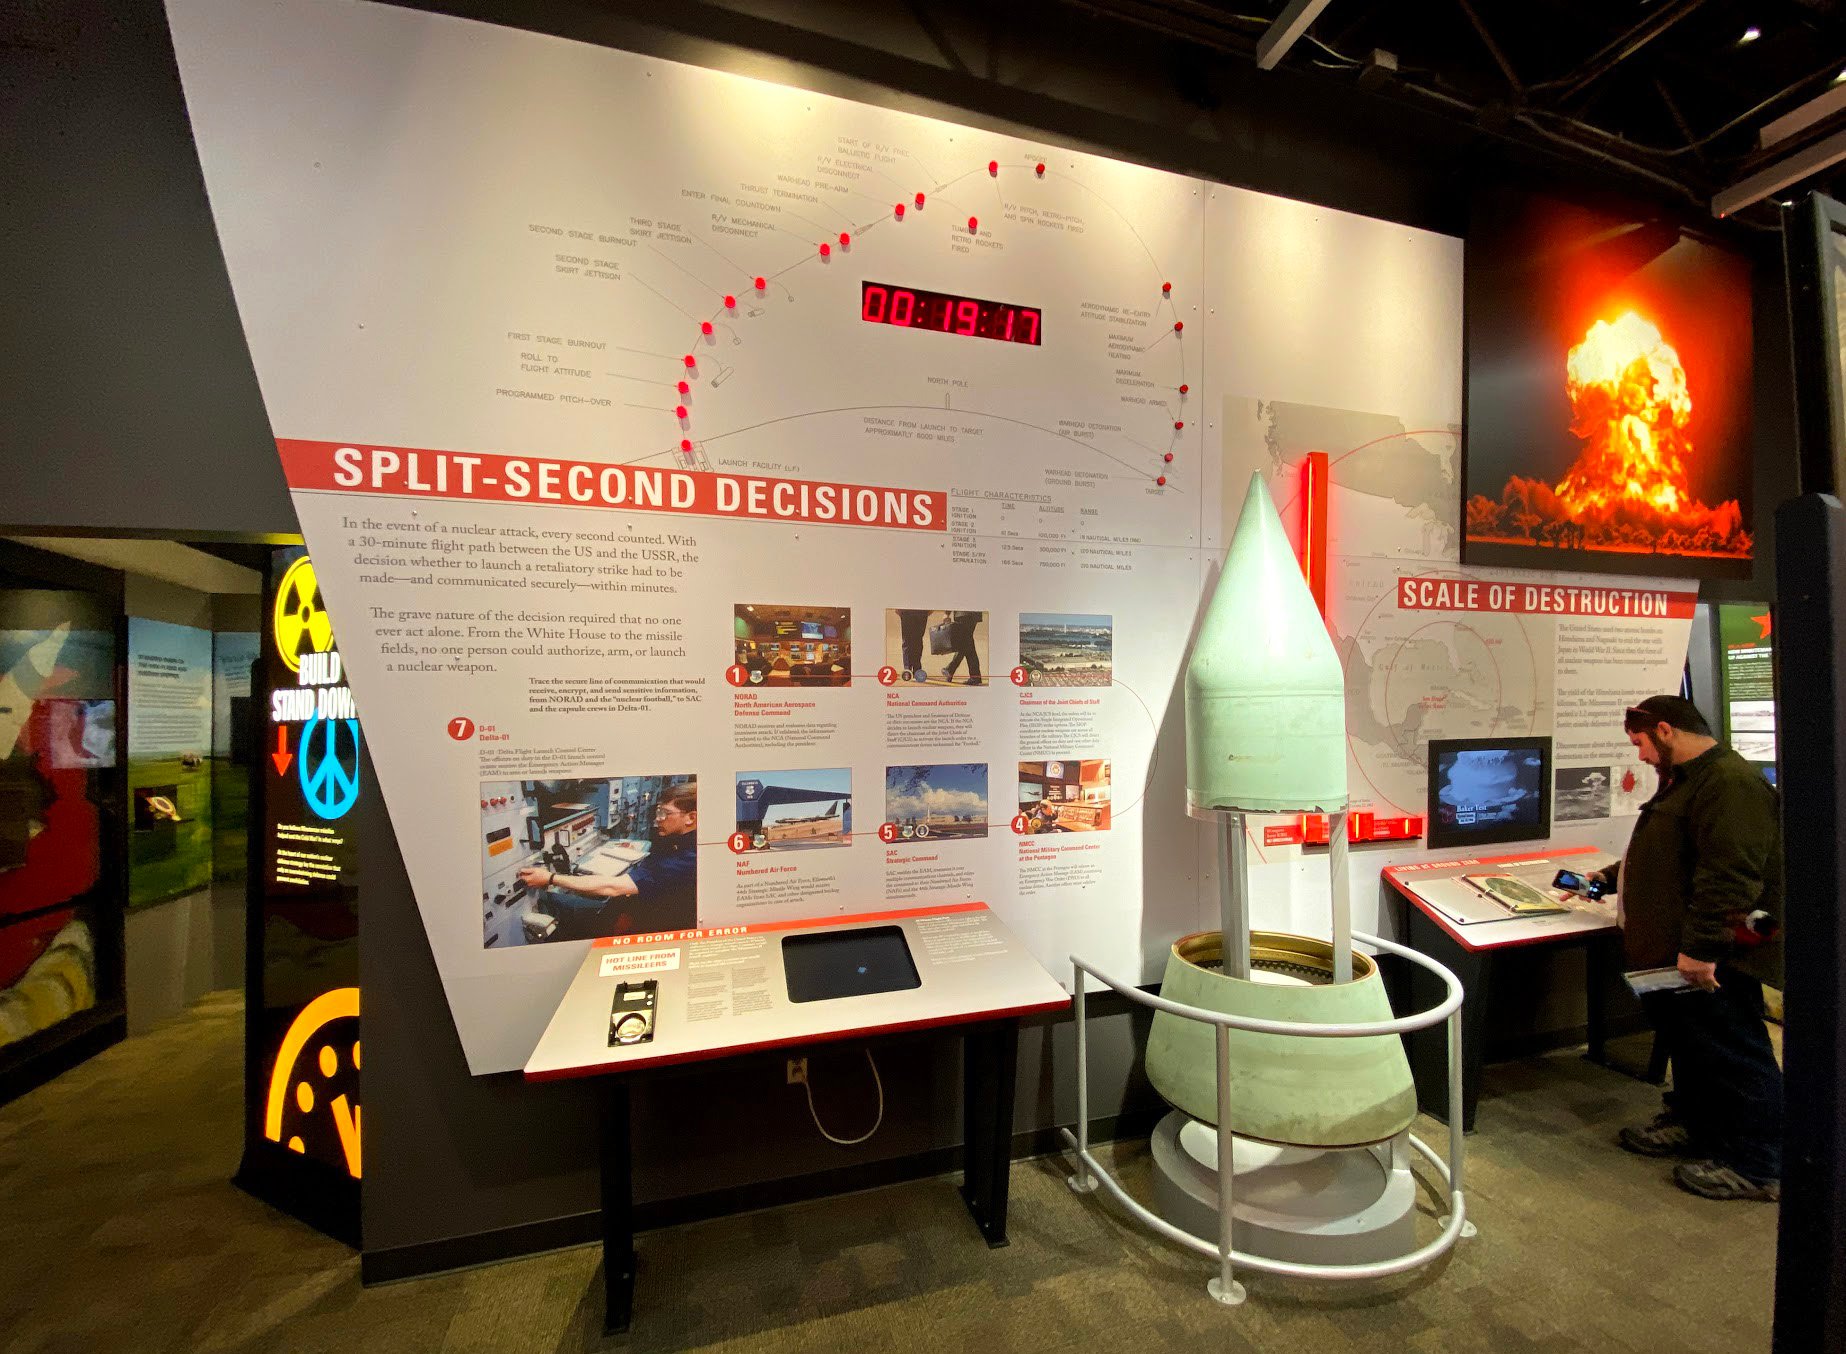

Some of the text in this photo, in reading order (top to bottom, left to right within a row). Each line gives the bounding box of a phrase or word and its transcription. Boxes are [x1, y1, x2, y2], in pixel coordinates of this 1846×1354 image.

[529, 225, 638, 246] SECOND STAGE BURNOUT
[555, 255, 620, 270] SECOND STAGE
[556, 266, 621, 280] SKIRT JETTISON
[863, 287, 1040, 343] 00:19:17
[508, 332, 607, 350] FIRST STAGE BURNOUT
[521, 353, 559, 363] ROLL TO
[521, 364, 592, 378] FLIGHT ATTITUDE
[496, 389, 612, 406] PROGRAMMED PITCH-OVER
[719, 459, 748, 467] LAUNCH
[752, 462, 782, 470] FACILITY
[334, 448, 933, 526] SPLIT-SECOND DECISIONS
[951, 489, 1052, 501] FLIGHT CHARACTERISTICS
[343, 517, 358, 528] In
[362, 518, 383, 530] the
[387, 523, 421, 531] event
[424, 522, 438, 532] of
[452, 525, 495, 535] nuclear
[500, 527, 539, 539] attack,
[542, 532, 572, 542] every
[576, 532, 614, 542] second
[618, 534, 665, 544] counted.
[668, 535, 697, 546] With
[360, 537, 428, 549] 30-minute
[432, 539, 465, 554] flight
[469, 542, 496, 555] path
[500, 543, 548, 555] between
[553, 546, 571, 556] the
[575, 546, 593, 557] US
[597, 548, 617, 558] and
[621, 549, 638, 559] the
[642, 550, 680, 562] USSR,
[682, 552, 699, 562] the
[354, 554, 407, 566] decision
[411, 557, 462, 568] whether
[466, 561, 478, 569] to
[482, 559, 522, 570] launch
[536, 563, 595, 576] retaliatory
[598, 565, 629, 575] strike
[632, 566, 653, 576] had
[656, 569, 667, 577] to
[670, 568, 683, 578] be
[437, 578, 527, 587] communicated
[631, 583, 677, 593] minutes.
[1403, 580, 1668, 616] SCALE OF DESTRUCTION
[370, 607, 395, 618] The
[399, 612, 432, 622] grave
[478, 610, 493, 620] of
[495, 611, 514, 621] the
[518, 611, 565, 622] decision
[569, 614, 616, 626] required
[620, 614, 642, 624] that
[428, 627, 464, 637] alone.
[468, 627, 500, 638] From
[505, 628, 524, 638] the
[527, 628, 566, 639] White
[569, 629, 606, 639] House
[610, 632, 622, 640] to
[625, 630, 643, 640] the
[646, 631, 683, 641] missile
[381, 643, 419, 655] fields,
[468, 648, 508, 658] person
[512, 645, 544, 655] could
[548, 646, 605, 657] authorize,
[608, 649, 633, 657] arm,
[650, 647, 686, 657] launch
[300, 652, 340, 685] BUILD
[398, 661, 443, 671] nuclear
[447, 664, 497, 675] weapon.
[732, 668, 740, 682] 1
[882, 668, 892, 683] 2
[1015, 669, 1023, 683] 3
[272, 688, 315, 721] STAND
[455, 720, 467, 737] 7
[884, 825, 892, 839] 5
[1015, 818, 1023, 831] 4
[734, 835, 743, 850] 6
[637, 934, 674, 943] ROOM
[680, 931, 703, 939] FOR
[709, 927, 748, 936] ERROR
[606, 956, 625, 964] HOT
[650, 952, 676, 960] FROM
[613, 961, 667, 971] MISSILEERS
